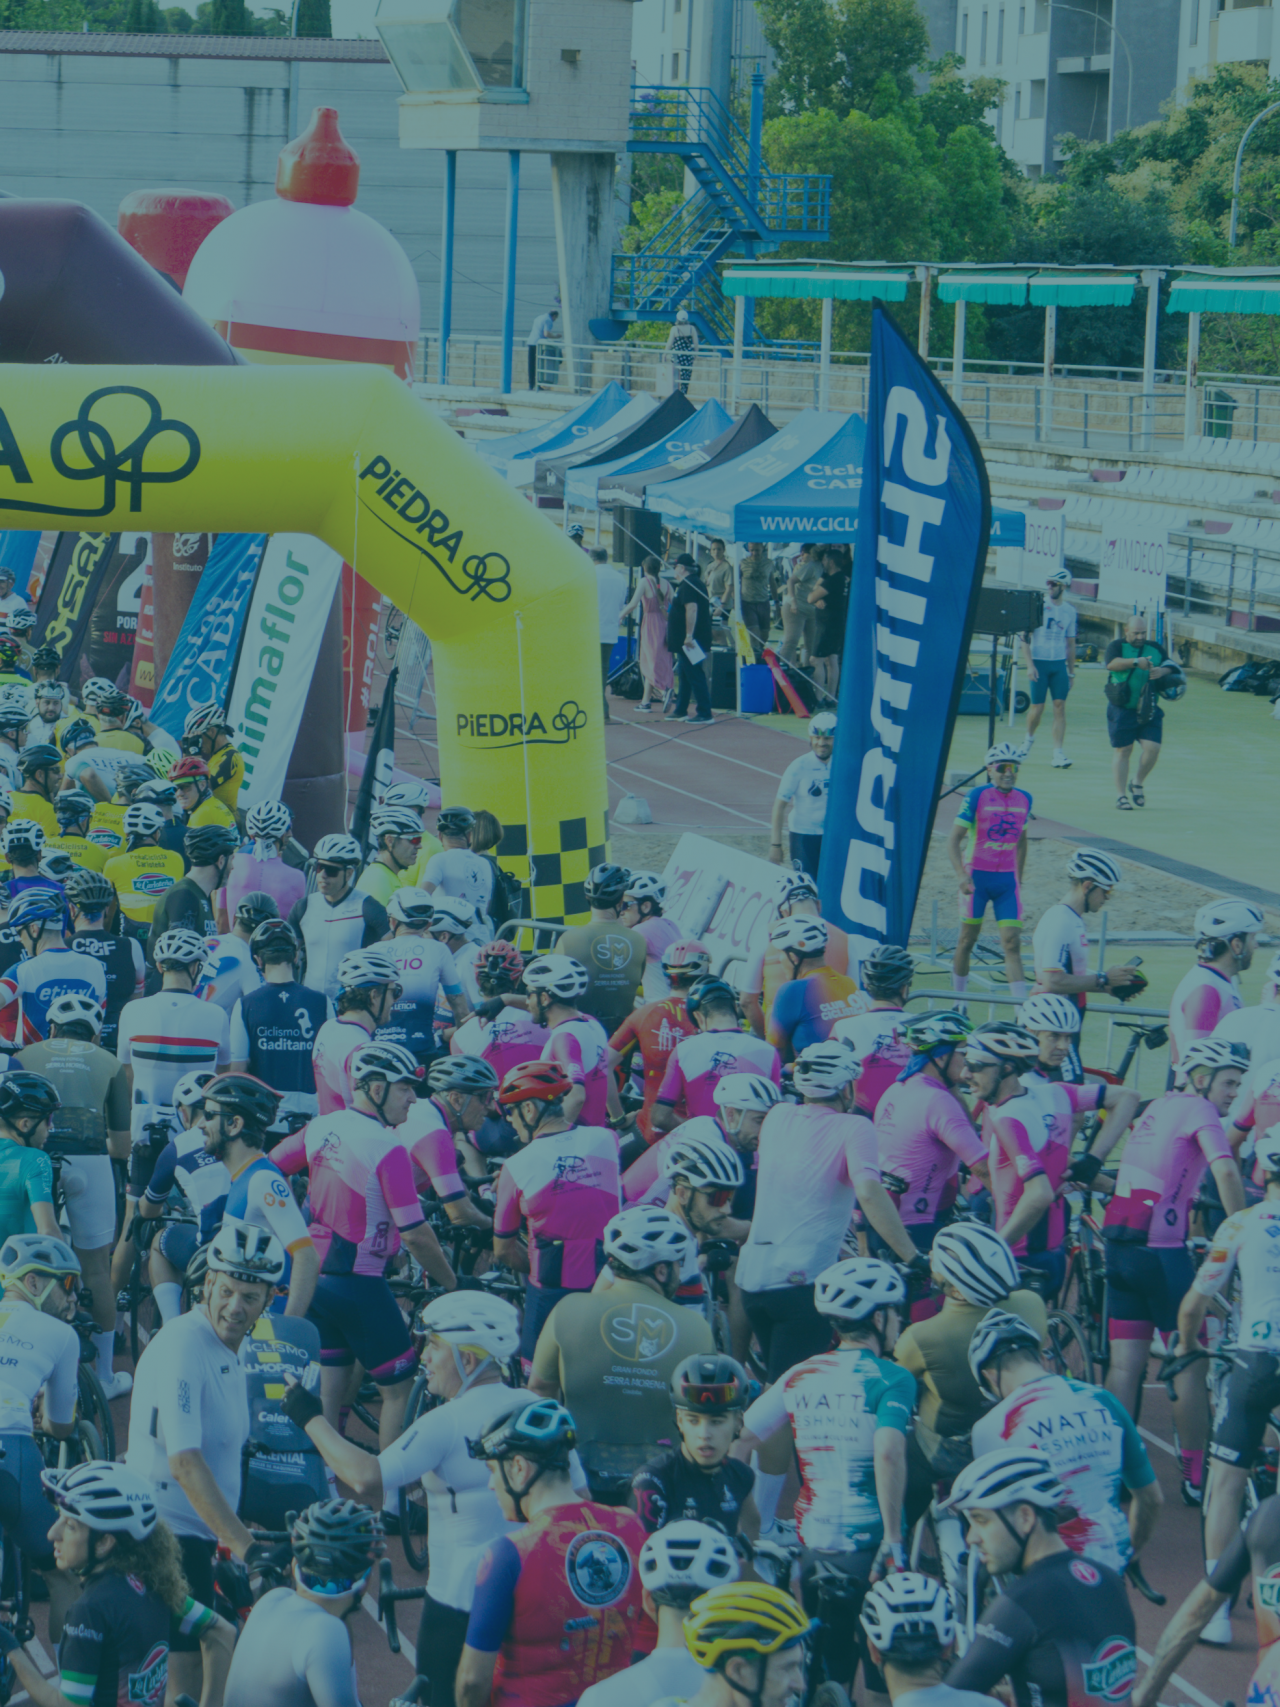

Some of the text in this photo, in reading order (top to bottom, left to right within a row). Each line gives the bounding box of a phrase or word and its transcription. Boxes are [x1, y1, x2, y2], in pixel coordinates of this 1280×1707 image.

[1116, 536, 1166, 577] IMDECO
[172, 561, 203, 572] Instituto
[256, 1025, 301, 1037] Ciclismo
[257, 1038, 314, 1051] Gaditano
[611, 1365, 658, 1376] GRAN FONDO
[603, 1375, 667, 1390] SIERRA MORENA
[793, 1393, 863, 1411] WATT
[1027, 1407, 1110, 1439] WATT
